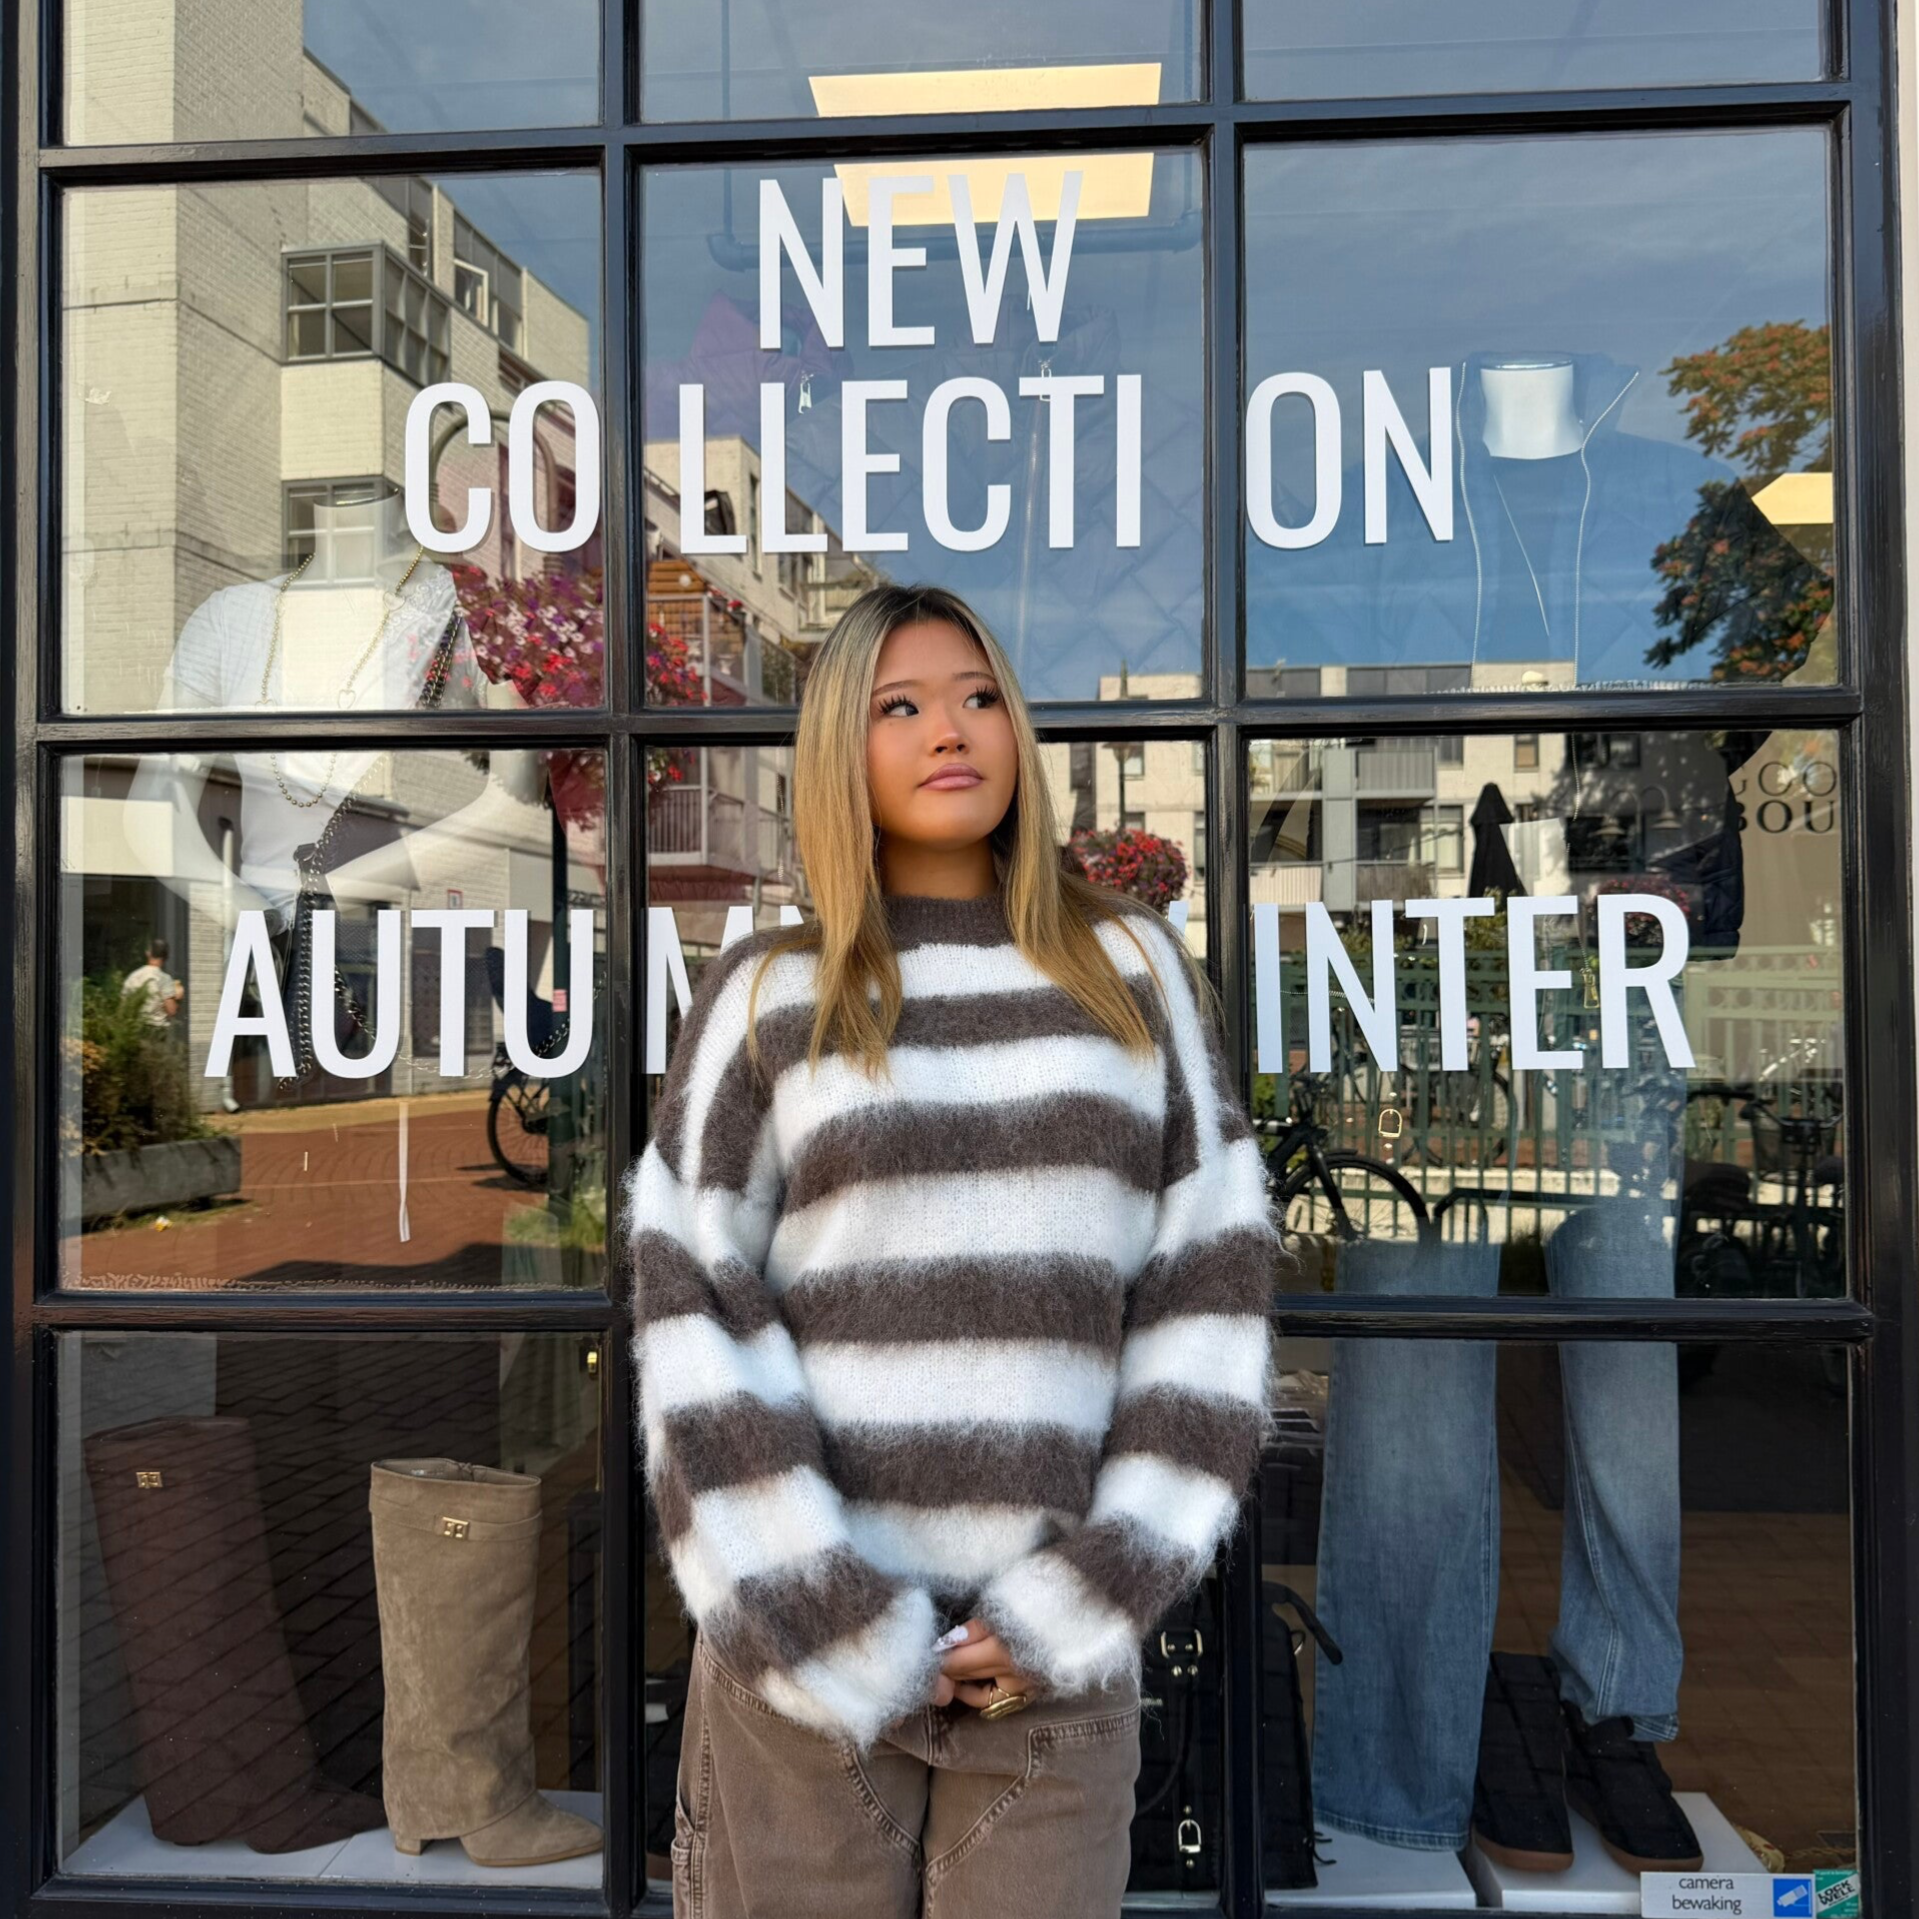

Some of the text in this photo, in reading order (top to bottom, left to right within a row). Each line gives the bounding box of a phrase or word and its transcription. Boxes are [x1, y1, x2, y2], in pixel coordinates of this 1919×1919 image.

[760, 171, 1082, 349] NEW
[204, 893, 1696, 1079] AUTUM INTER
[1679, 1878, 1734, 1890] camera
[1818, 1879, 1850, 1899] LOCK
[1672, 1895, 1742, 1914] bewaking
[1820, 1887, 1855, 1905] WELL
